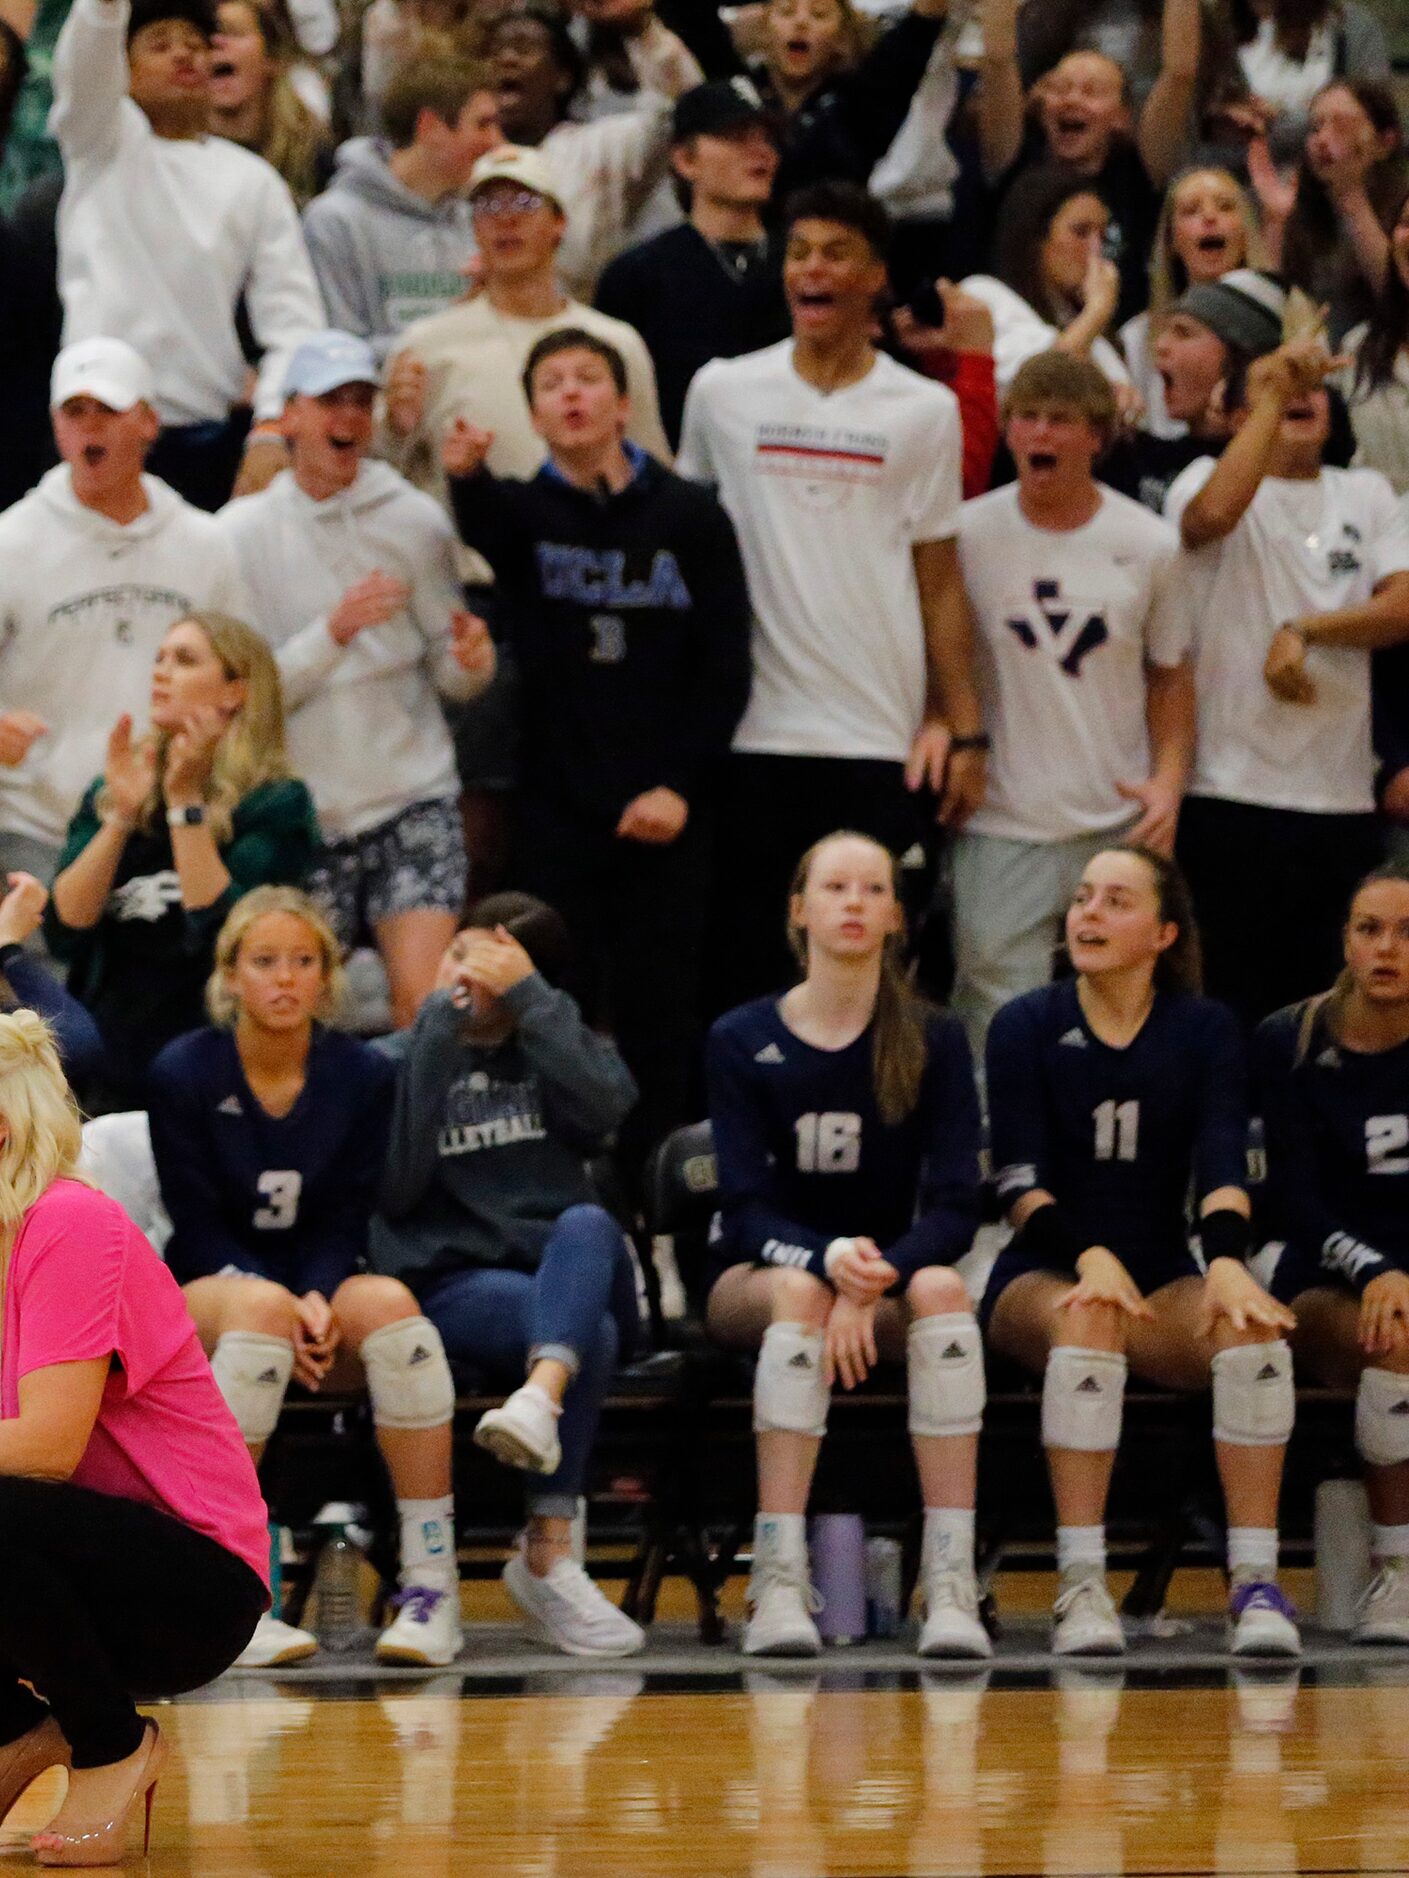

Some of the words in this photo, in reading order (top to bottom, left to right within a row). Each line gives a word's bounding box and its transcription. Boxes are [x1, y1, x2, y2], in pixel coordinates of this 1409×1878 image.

[535, 541, 691, 608] UCLA
[796, 1112, 862, 1172] 16
[1092, 1100, 1139, 1161] 11
[254, 1170, 302, 1229] 3
